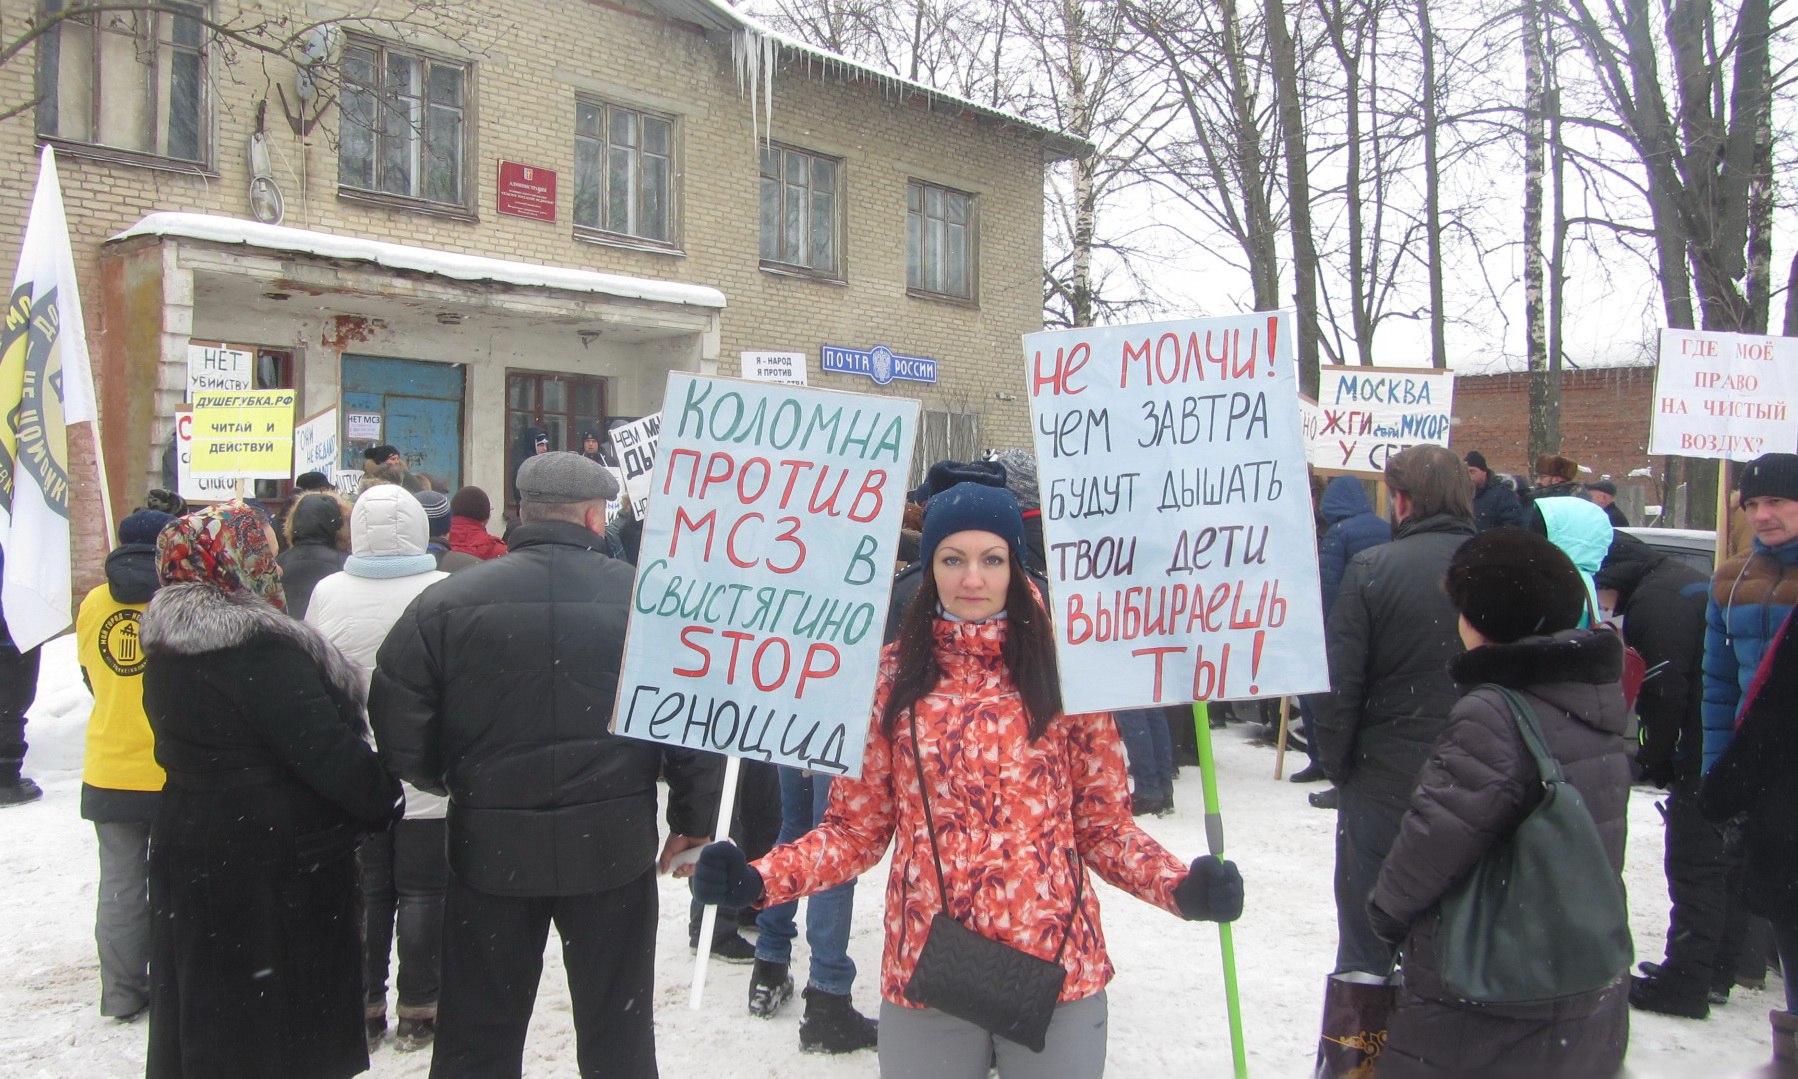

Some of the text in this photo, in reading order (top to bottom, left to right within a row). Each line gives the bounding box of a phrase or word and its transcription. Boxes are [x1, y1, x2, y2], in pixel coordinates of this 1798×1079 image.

[204, 348, 243, 371] НЕТ
[756, 356, 761, 364] Я
[767, 357, 792, 366] НАРОД
[1120, 316, 1279, 389] МОЛЧИ!
[1681, 338, 1774, 361] ГДЕ МОЁ
[757, 368, 792, 377] Я ПРОТИВ
[826, 350, 935, 379] ПОЧТА РОССИИ
[191, 373, 250, 391] УБИЙСТВУ
[1335, 375, 1431, 405] МОСКВА
[1694, 371, 1758, 392] ПРАВО
[195, 396, 293, 409] ДУШЕГУБКА.РФ
[1661, 397, 1788, 421] НА ЧИСТЫЙ
[211, 420, 275, 433] ЧИТАЙ И
[347, 415, 362, 424] НЕТ
[677, 378, 902, 463] КОЛОМНА
[1137, 390, 1268, 449] ЗАВТРА
[1319, 409, 1373, 437] ЖГИ
[1400, 413, 1449, 440] МУСОР
[209, 440, 274, 455] ДЕЙСТВУЙ
[1338, 440, 1357, 466] У
[1680, 432, 1764, 453] ВОЗДУХ?
[623, 439, 658, 480] ДЫ
[663, 448, 888, 523] ПРОТИВ
[1048, 459, 1283, 520] БУДУТ ДЫШАТЬ
[668, 505, 879, 586] МСЗ В
[1050, 535, 1137, 582] ТВОИ
[672, 625, 841, 699] STOP
